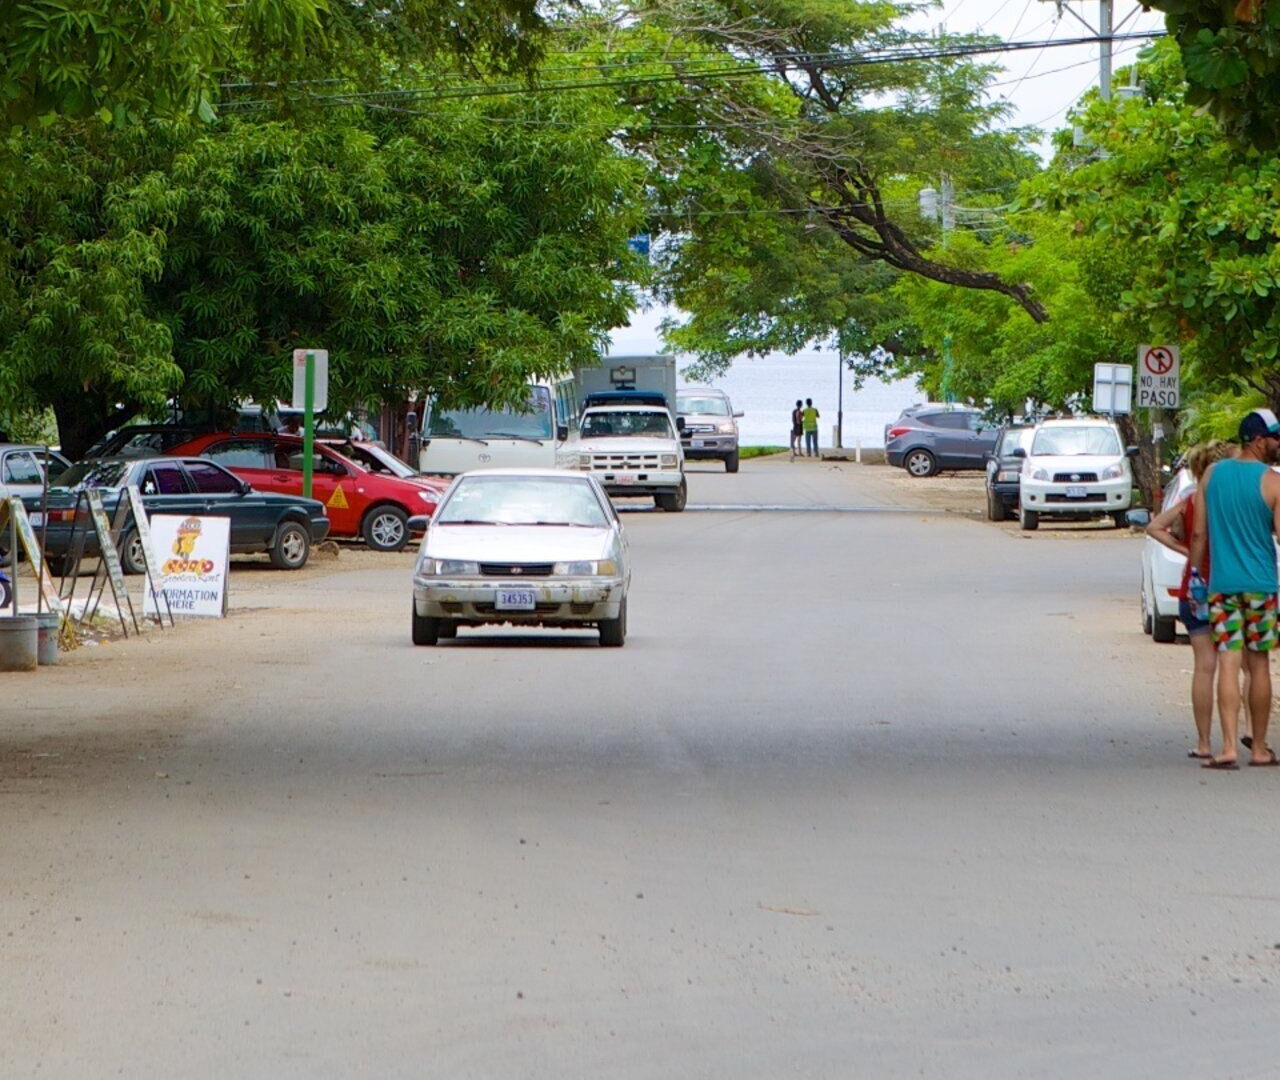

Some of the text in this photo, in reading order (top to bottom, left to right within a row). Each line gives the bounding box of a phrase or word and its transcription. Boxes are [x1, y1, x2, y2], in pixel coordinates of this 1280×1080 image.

[1141, 375, 1176, 388] NO HAY
[1141, 390, 1176, 406] PASO
[148, 588, 218, 601] INFORMATION
[168, 600, 195, 609] HERE
